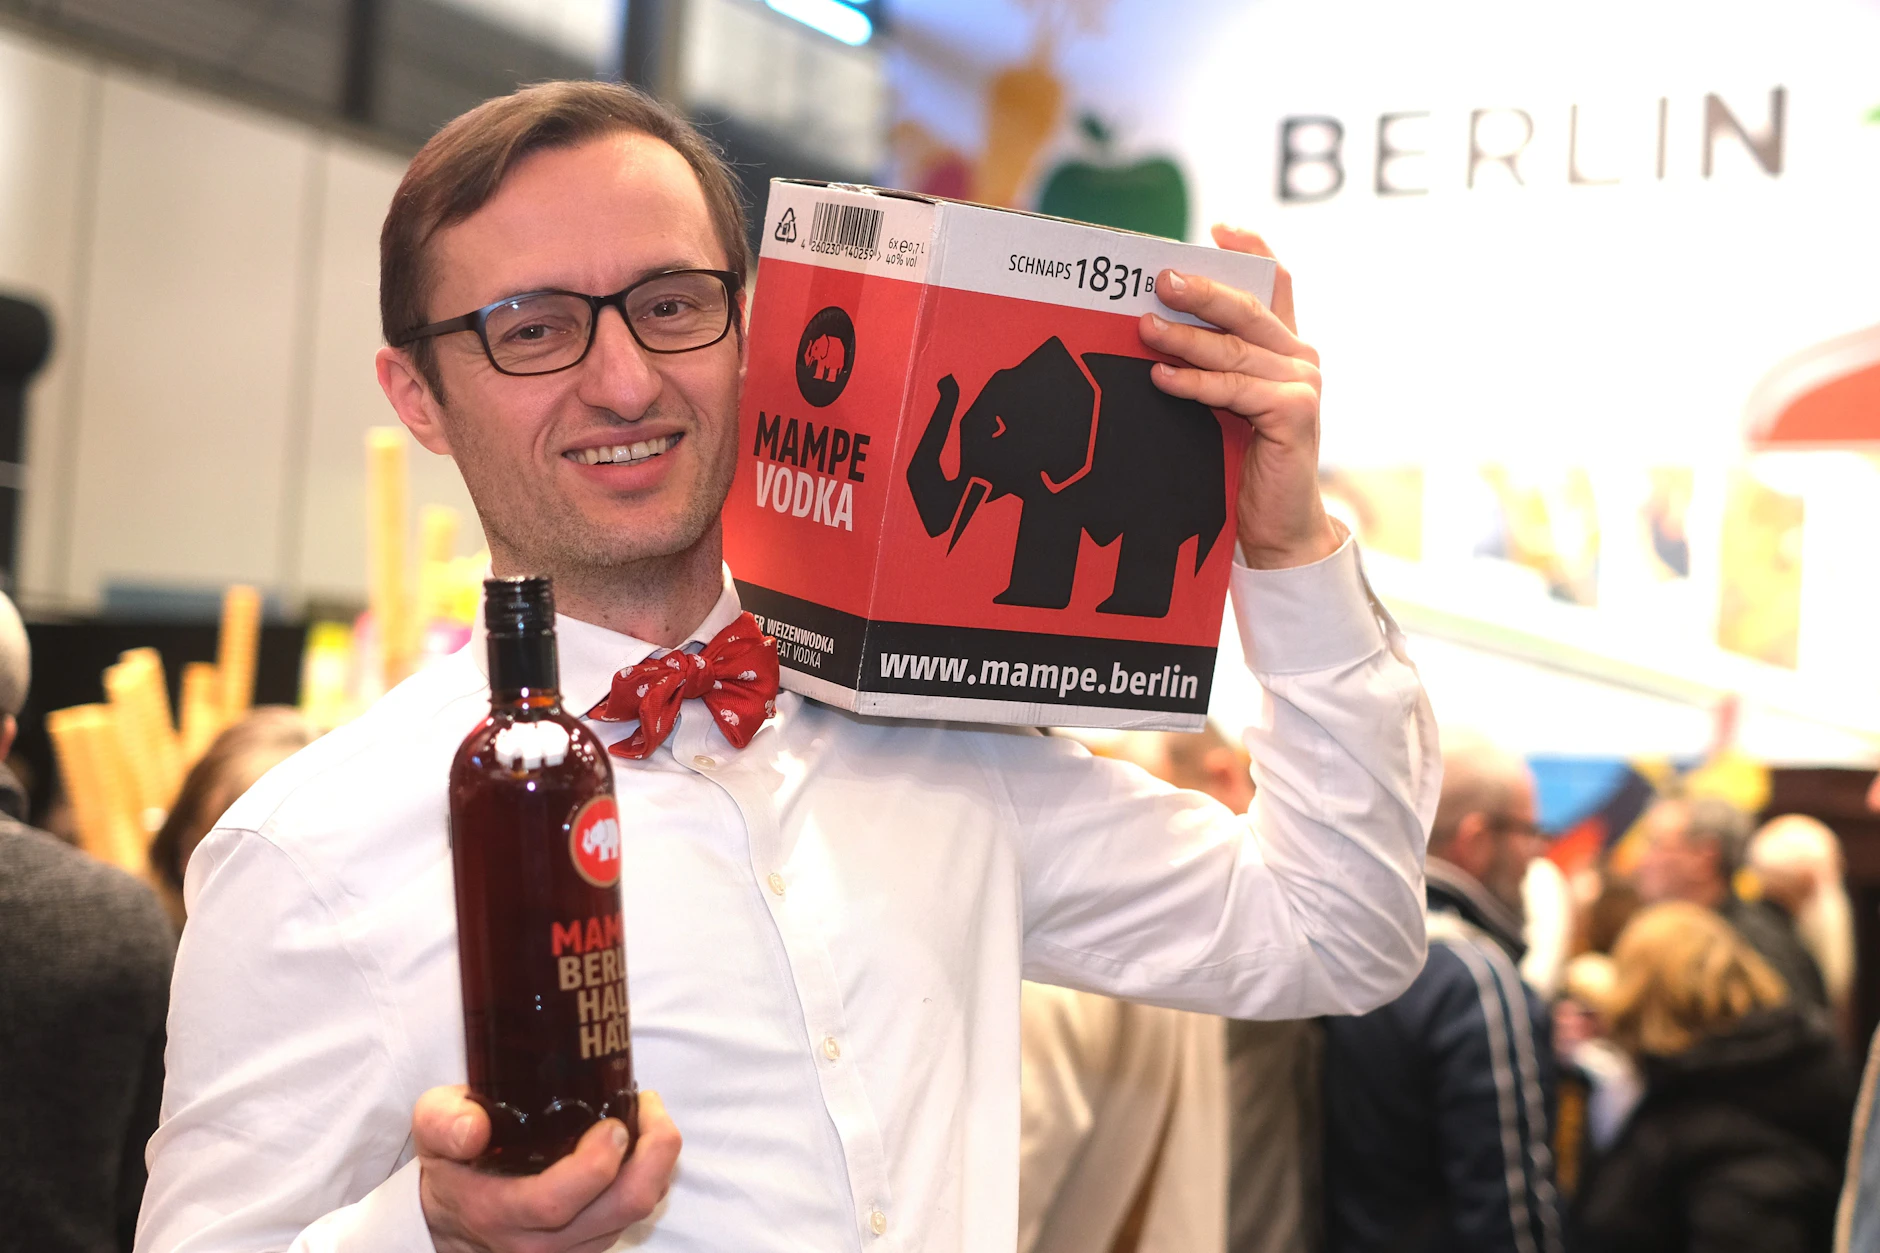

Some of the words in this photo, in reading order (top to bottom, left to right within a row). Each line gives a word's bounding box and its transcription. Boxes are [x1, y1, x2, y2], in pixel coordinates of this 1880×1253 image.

[1275, 84, 1789, 205] BERLIN
[800, 239, 806, 250] 4
[810, 240, 841, 256] 260230
[844, 245, 875, 261] 140259
[885, 253, 904, 266] 40%
[905, 255, 918, 267] vol
[1008, 254, 1072, 280] SCHNAPS
[1076, 256, 1143, 300] 1831
[753, 411, 871, 483] MAMPE
[756, 461, 853, 532] VODKA
[766, 618, 835, 655] WEIZENWODKA
[793, 644, 821, 669] VODKA
[880, 652, 1198, 699] www.mampe.berlin
